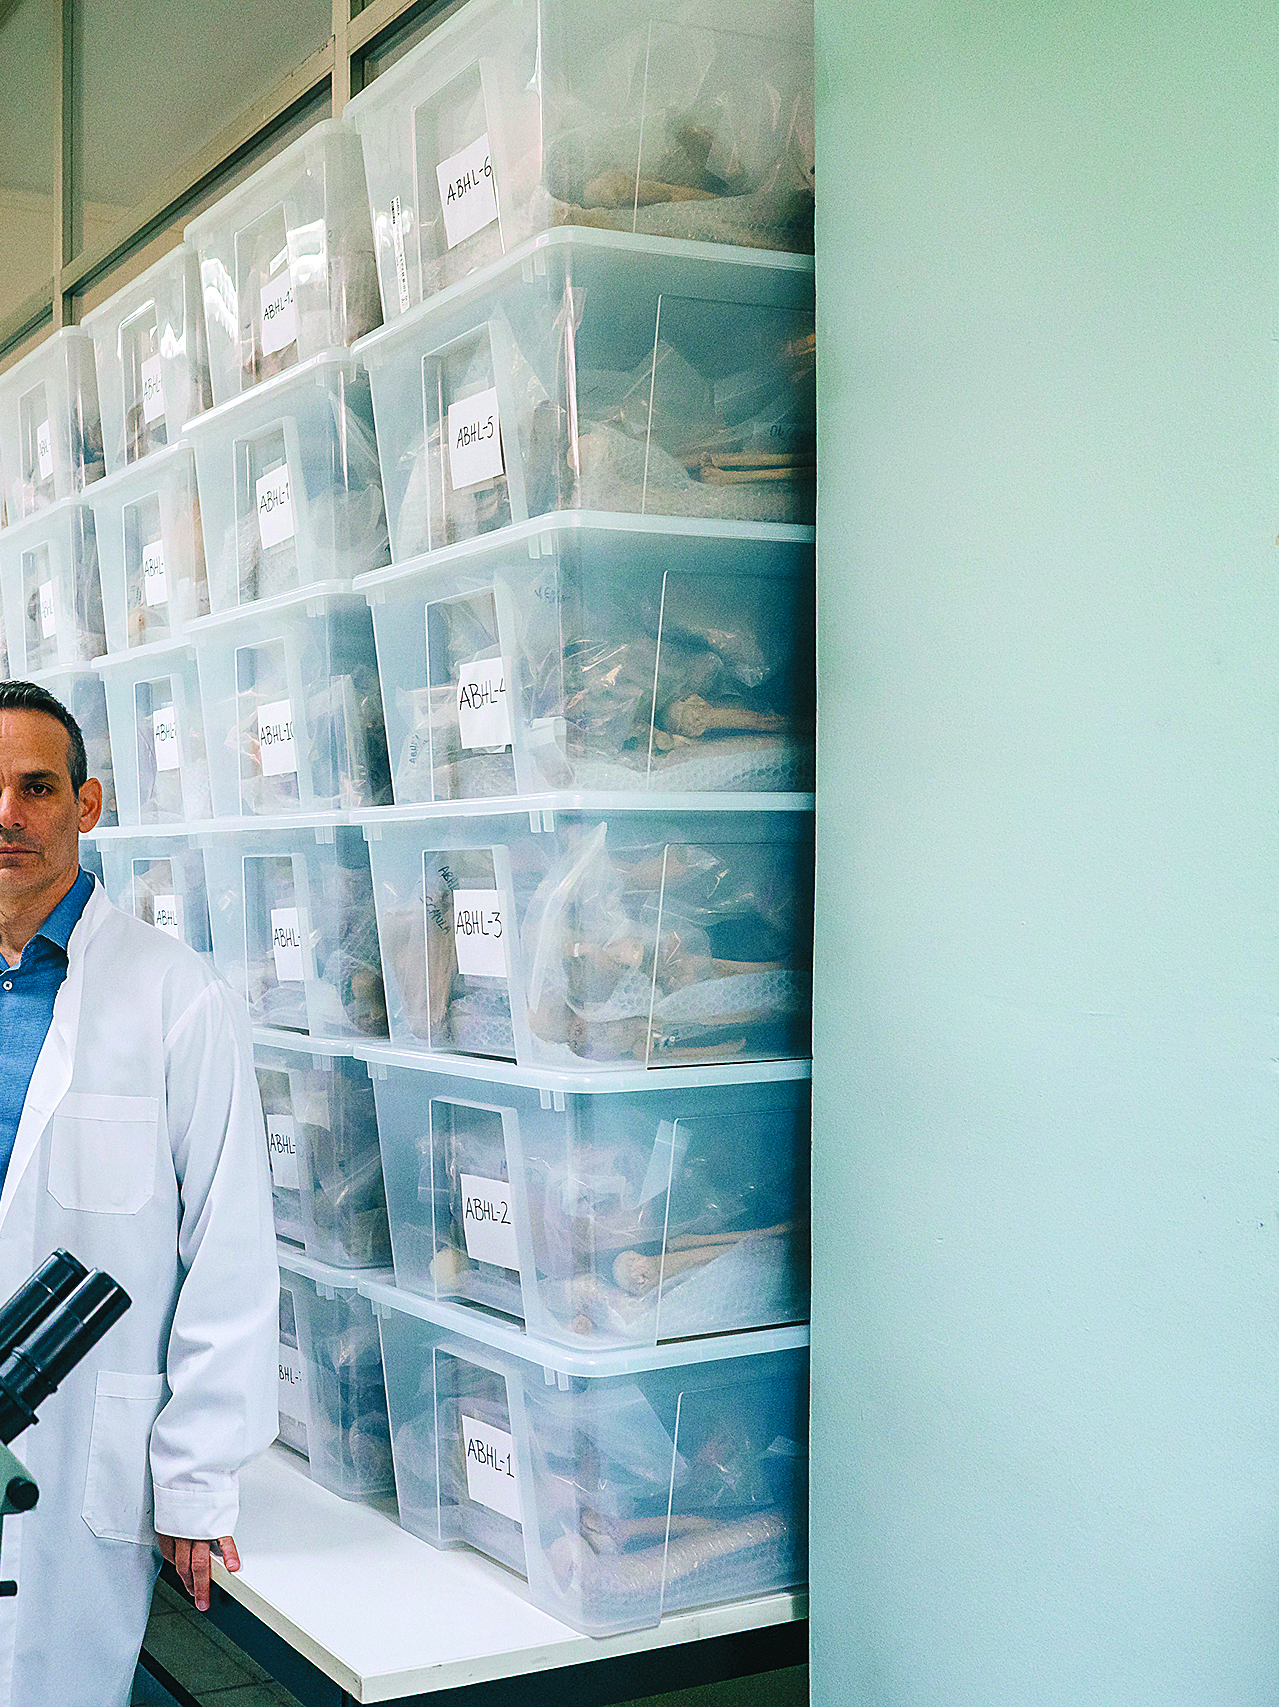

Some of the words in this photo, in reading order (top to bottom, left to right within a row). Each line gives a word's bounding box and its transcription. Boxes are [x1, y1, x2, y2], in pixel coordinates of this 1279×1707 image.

[446, 155, 492, 206] ABHL-6
[456, 415, 494, 449] ABHL-5
[456, 909, 503, 938] ABHL-3
[465, 1197, 512, 1225] ABHL-2
[467, 1438, 515, 1479] ABHL-1
